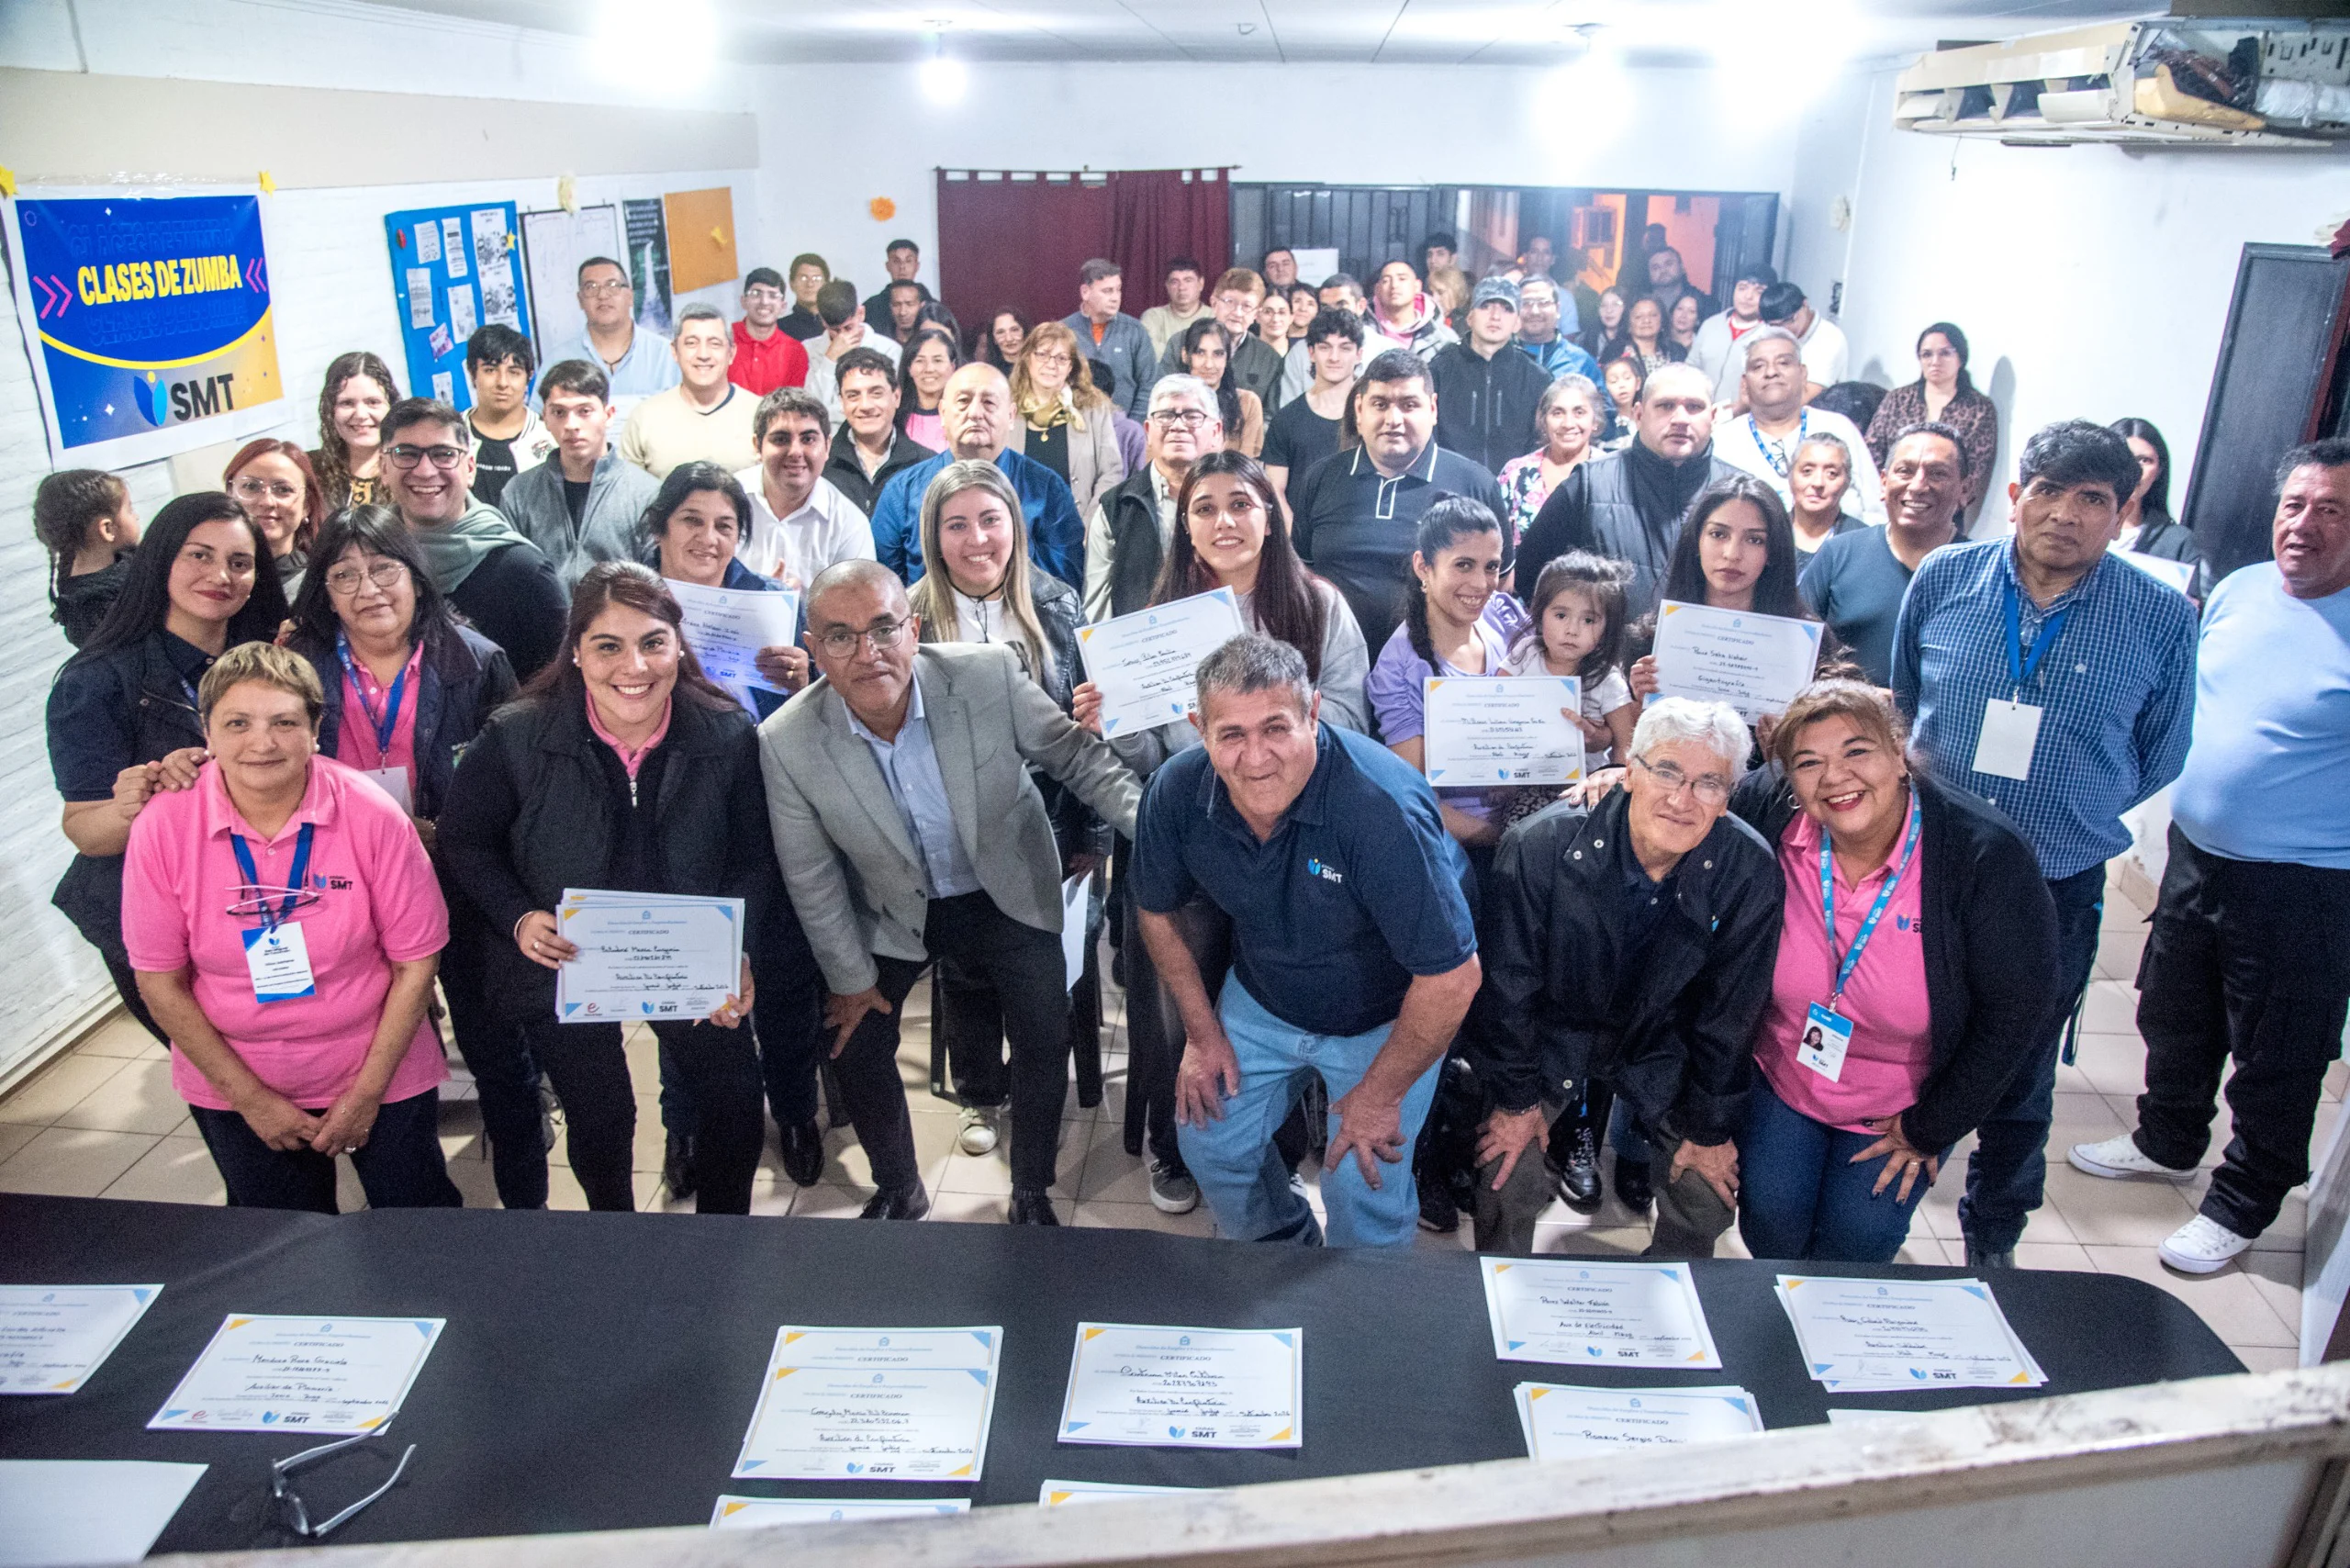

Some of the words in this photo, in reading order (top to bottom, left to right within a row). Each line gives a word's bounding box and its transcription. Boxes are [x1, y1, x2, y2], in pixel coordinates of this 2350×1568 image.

[77, 262, 155, 306] CLASES
[154, 259, 182, 298] DE
[179, 254, 243, 295] ZUMBA
[170, 373, 235, 422] SMT
[1322, 868, 1343, 883] SMT
[330, 879, 353, 891] SMT
[659, 1005, 679, 1014] SMT
[283, 1415, 311, 1424] SMT
[1191, 1430, 1217, 1439] SMT
[869, 1465, 896, 1473] SMT
